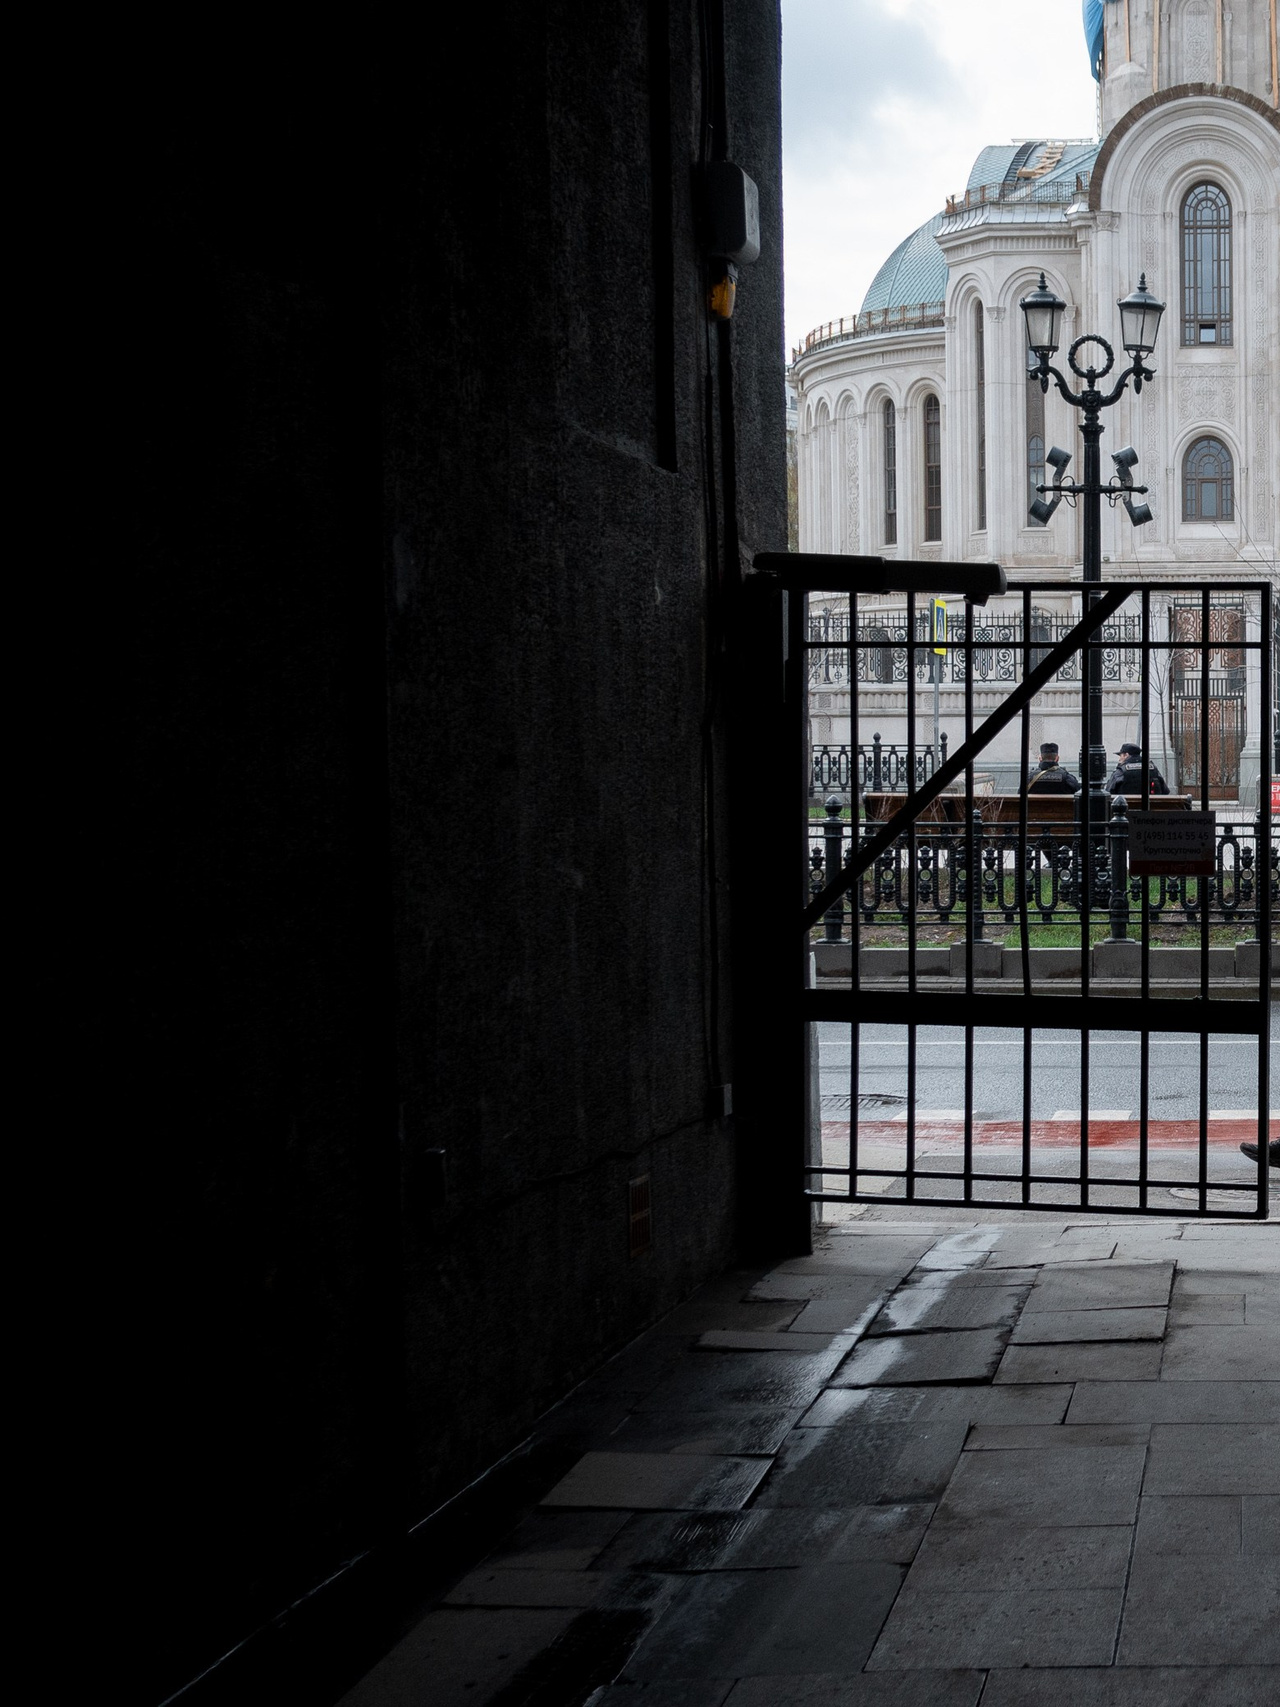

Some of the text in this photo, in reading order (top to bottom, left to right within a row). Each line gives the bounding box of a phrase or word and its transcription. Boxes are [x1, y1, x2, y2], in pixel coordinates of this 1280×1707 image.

[1132, 816, 1213, 827] Телефон диспетчера
[1136, 831, 1209, 842] 8 (495) 114 55 45
[1143, 845, 1202, 855] Круглосуточно
[1149, 863, 1168, 873] Пост
